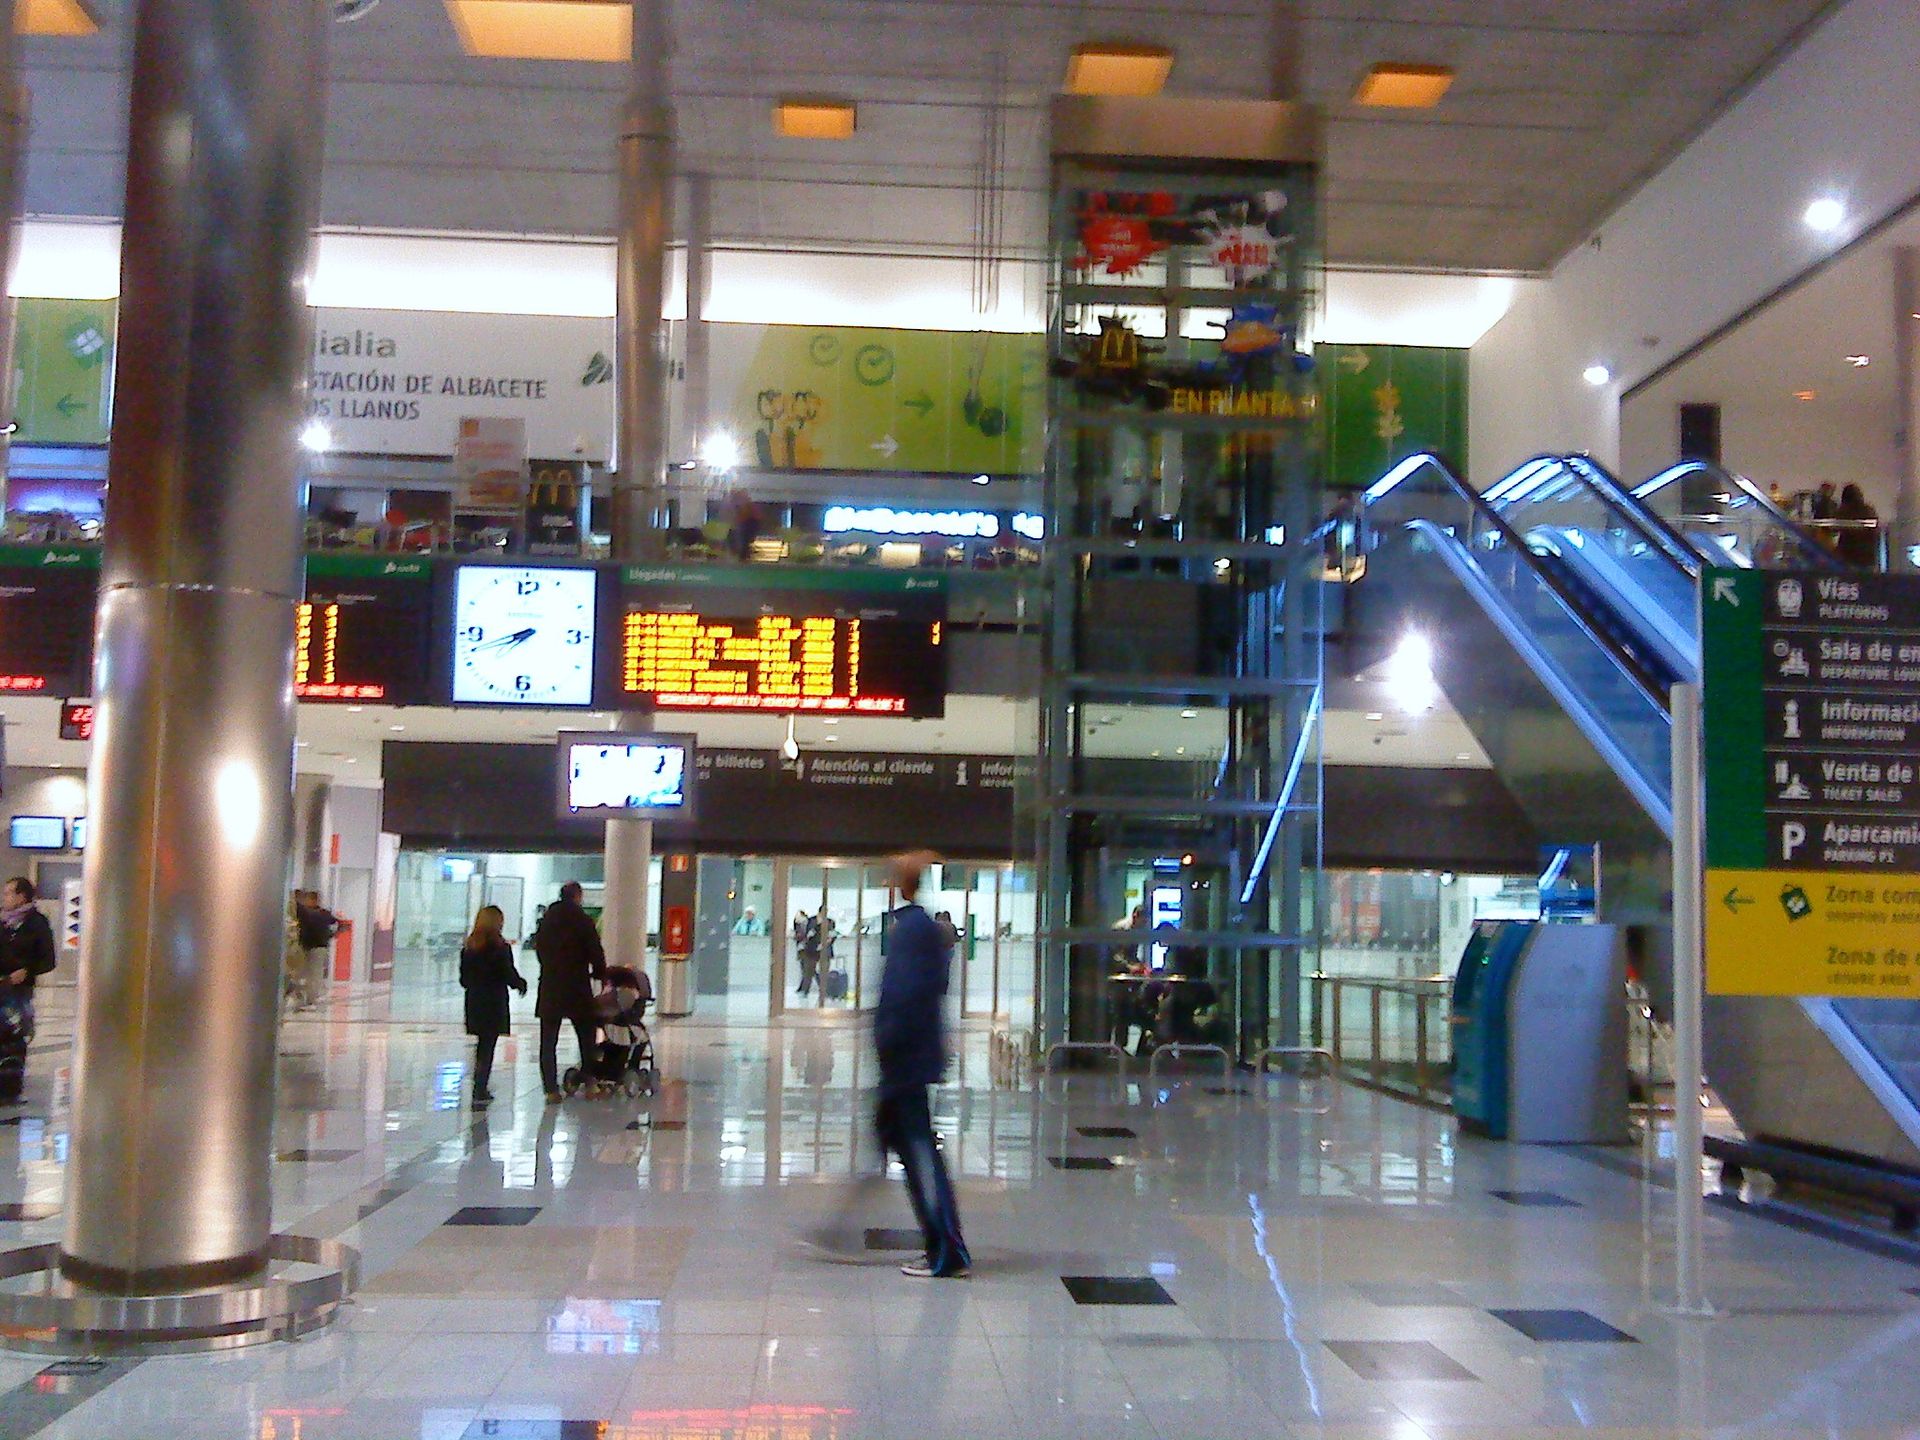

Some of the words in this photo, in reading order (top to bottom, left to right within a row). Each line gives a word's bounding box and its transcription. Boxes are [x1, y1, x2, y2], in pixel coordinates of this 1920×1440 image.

[319, 330, 397, 358] ialia
[406, 374, 433, 394] DE
[441, 376, 547, 399] ALBACETE
[339, 399, 420, 421] LLANOS
[517, 580, 541, 596] 12
[468, 625, 484, 642] 9
[566, 628, 582, 645] 3
[1820, 638, 1861, 661] Sala
[1867, 640, 1893, 662] de
[516, 674, 532, 692] 6
[1822, 698, 1920, 723] Informaci
[1822, 725, 1906, 741] INFORMATION
[811, 758, 869, 772] Atención
[872, 760, 886, 773] al
[889, 761, 933, 774] cliente
[1821, 759, 1880, 782] Venta
[1886, 761, 1913, 783] de
[1824, 821, 1920, 846] Aparcami
[1825, 885, 1875, 904] Zona
[1827, 946, 1875, 966] Zona
[1883, 948, 1907, 967] de
